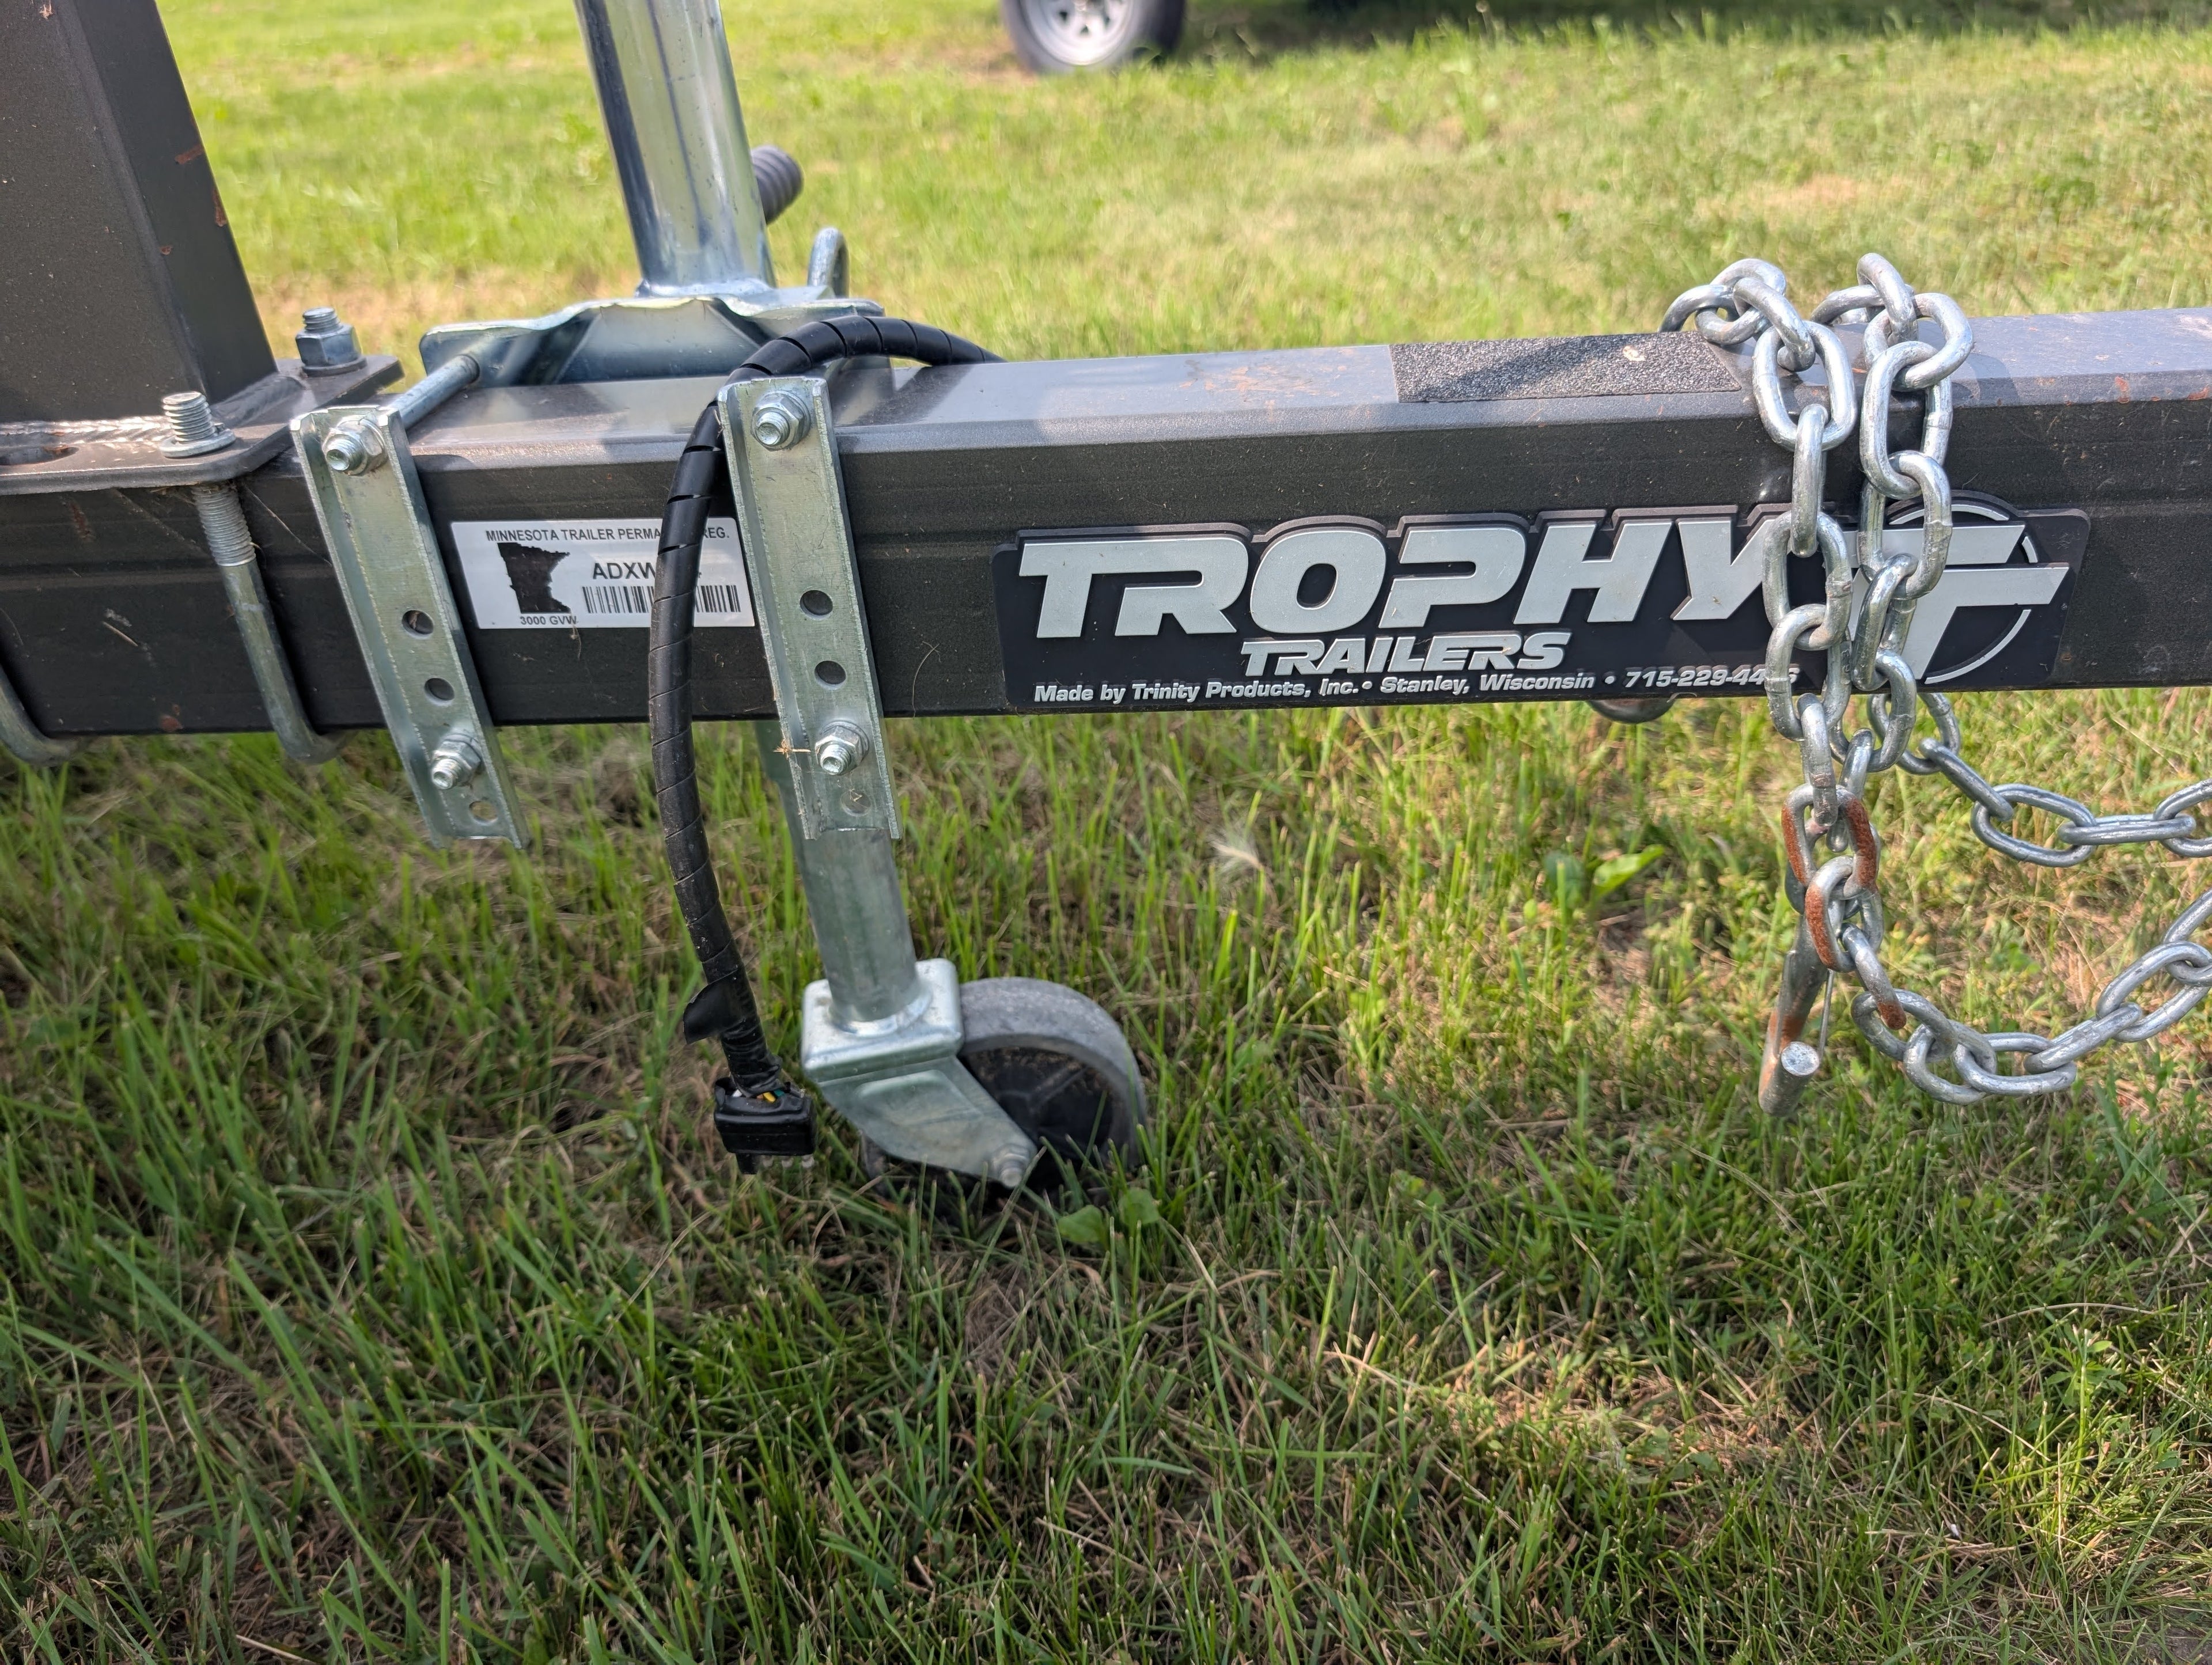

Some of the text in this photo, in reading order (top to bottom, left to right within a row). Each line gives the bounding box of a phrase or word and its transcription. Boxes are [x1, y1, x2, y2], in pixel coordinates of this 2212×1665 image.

[486, 529, 559, 541] MINNESOTA
[560, 529, 615, 540] TRAILER
[1018, 516, 1793, 639] TROPHY
[520, 616, 546, 625] 3000
[1240, 632, 1573, 677] TRAILERS
[1034, 666, 1801, 704] Made by Trinity Products, Inc. Stanley, Wisconsin 715-229-446
